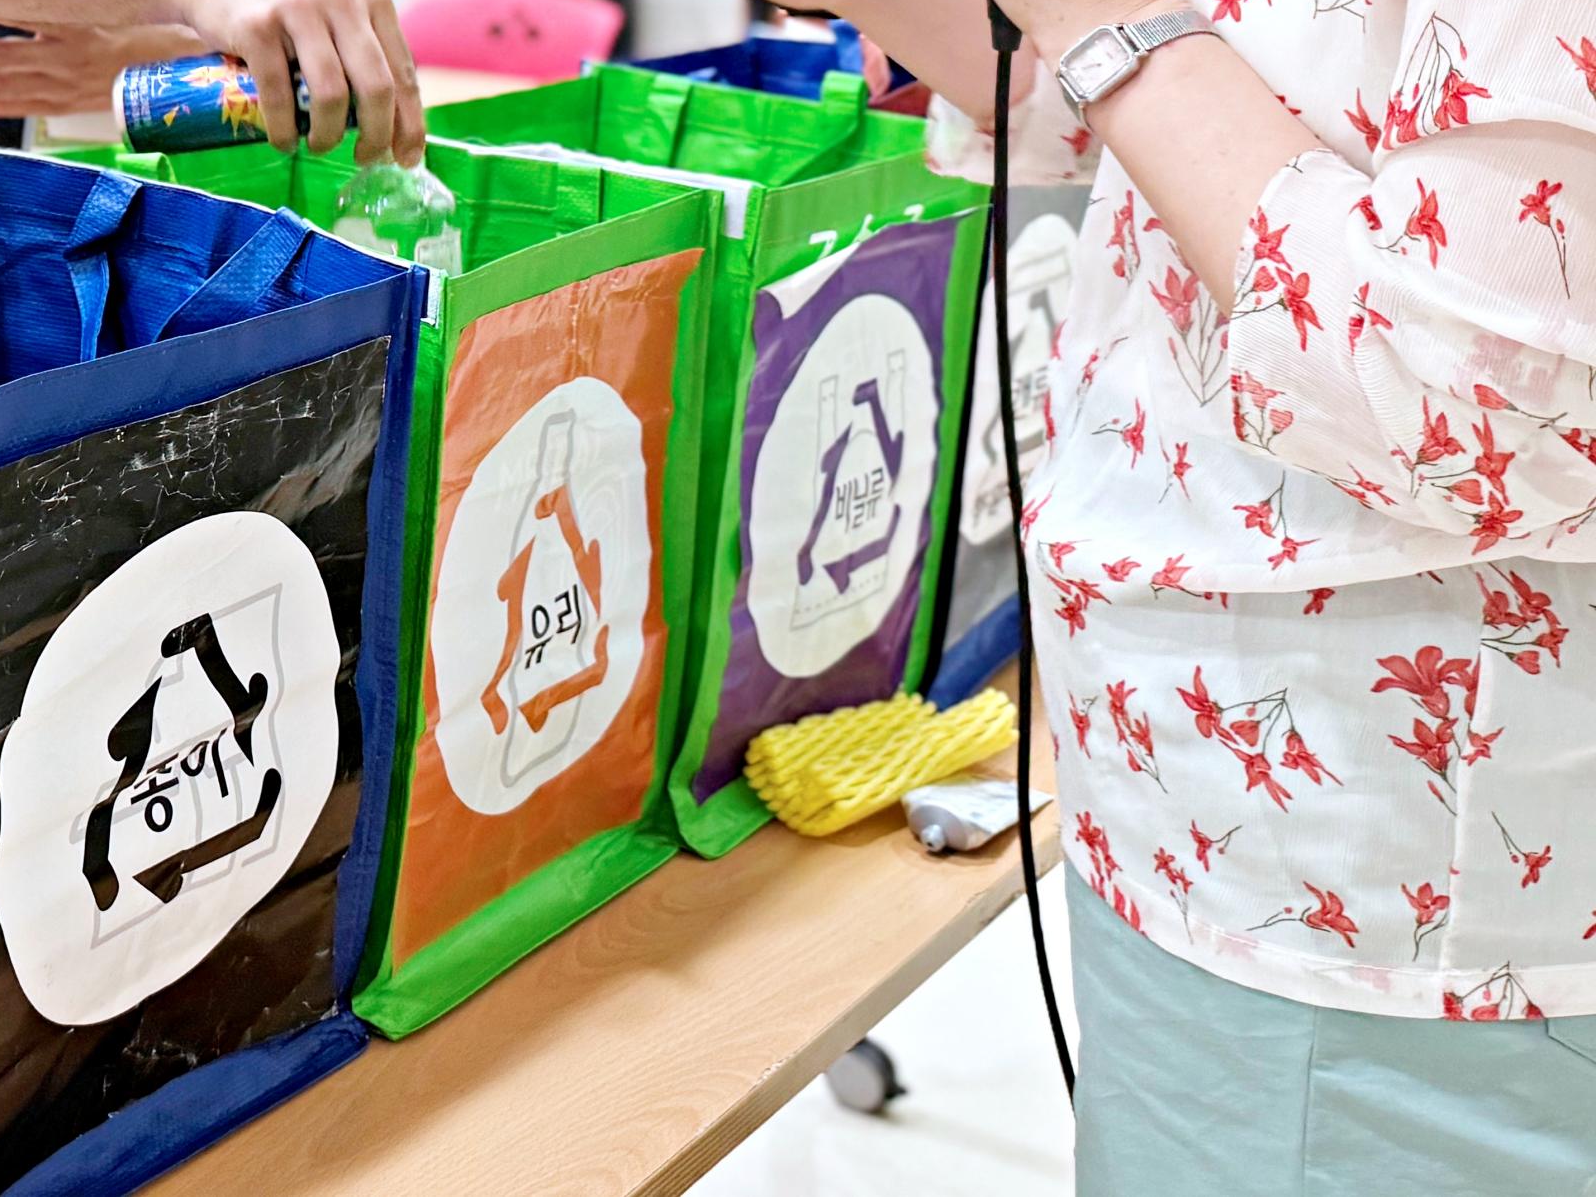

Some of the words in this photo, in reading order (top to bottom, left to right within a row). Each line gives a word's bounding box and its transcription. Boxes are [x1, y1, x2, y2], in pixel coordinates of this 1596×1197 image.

[835, 466, 884, 534] 비닐류
[524, 583, 582, 671] 유리
[130, 727, 229, 833] 종이
